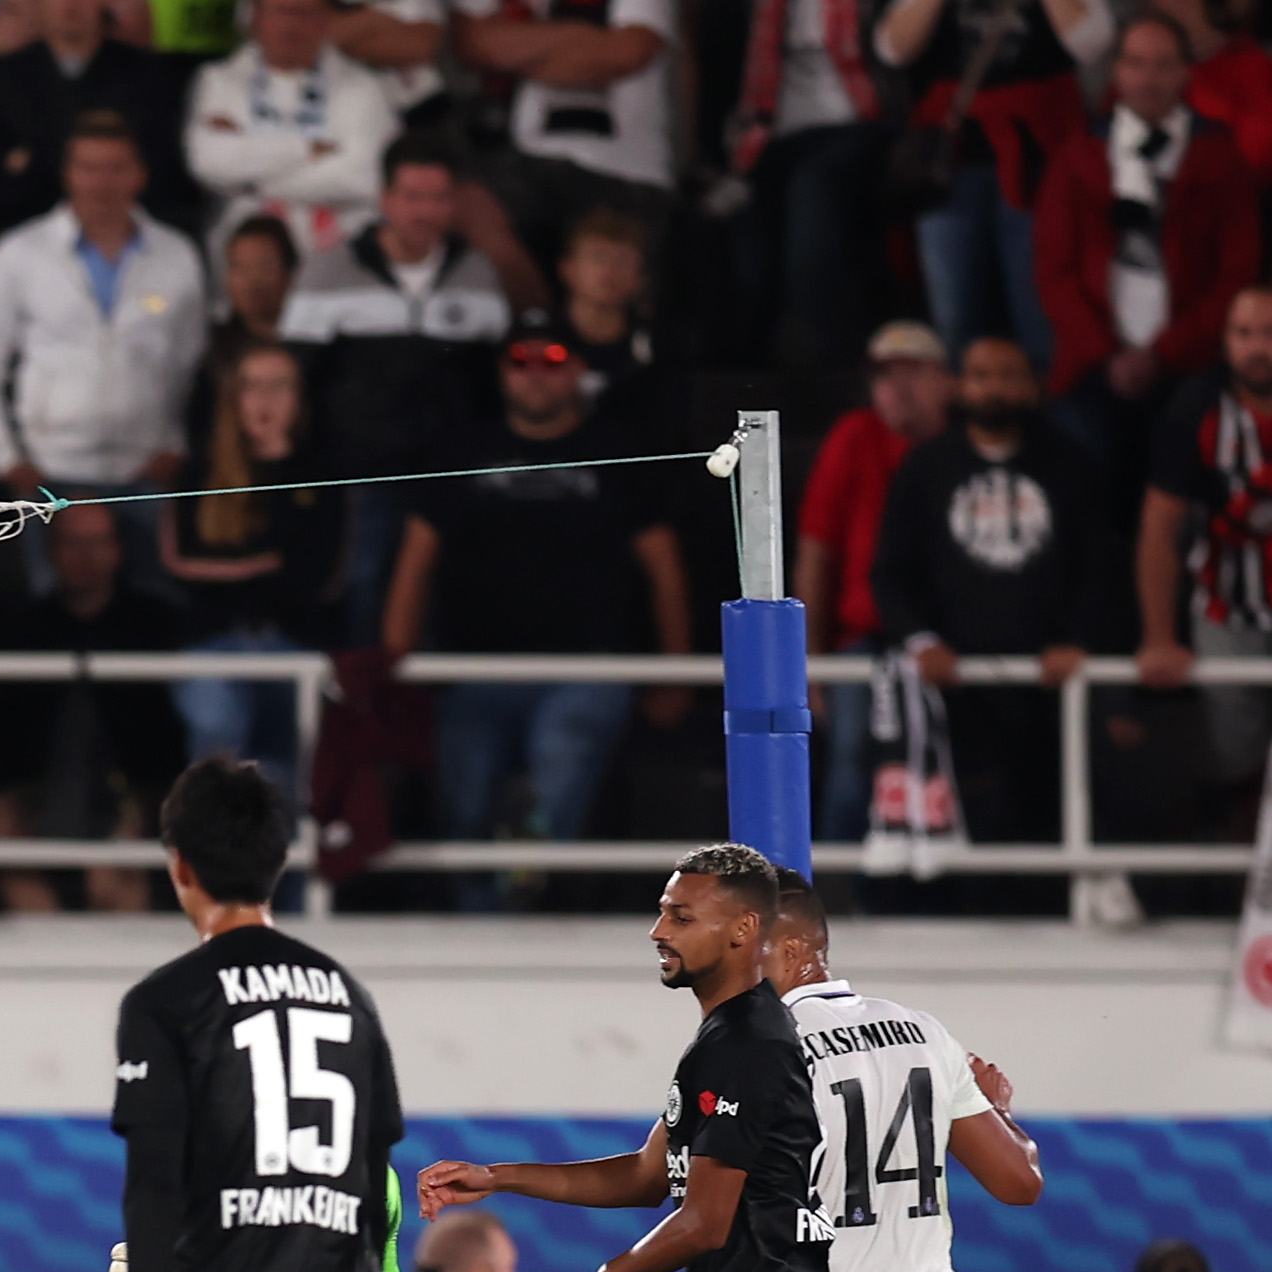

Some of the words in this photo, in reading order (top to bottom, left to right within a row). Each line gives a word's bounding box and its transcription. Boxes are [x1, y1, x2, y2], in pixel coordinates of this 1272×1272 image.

[218, 964, 350, 1006] KAMADA
[804, 1020, 926, 1060] CASEMIRO
[232, 1007, 356, 1177] 15
[830, 1067, 943, 1228] 14
[220, 1184, 361, 1235] FRANKFURT
